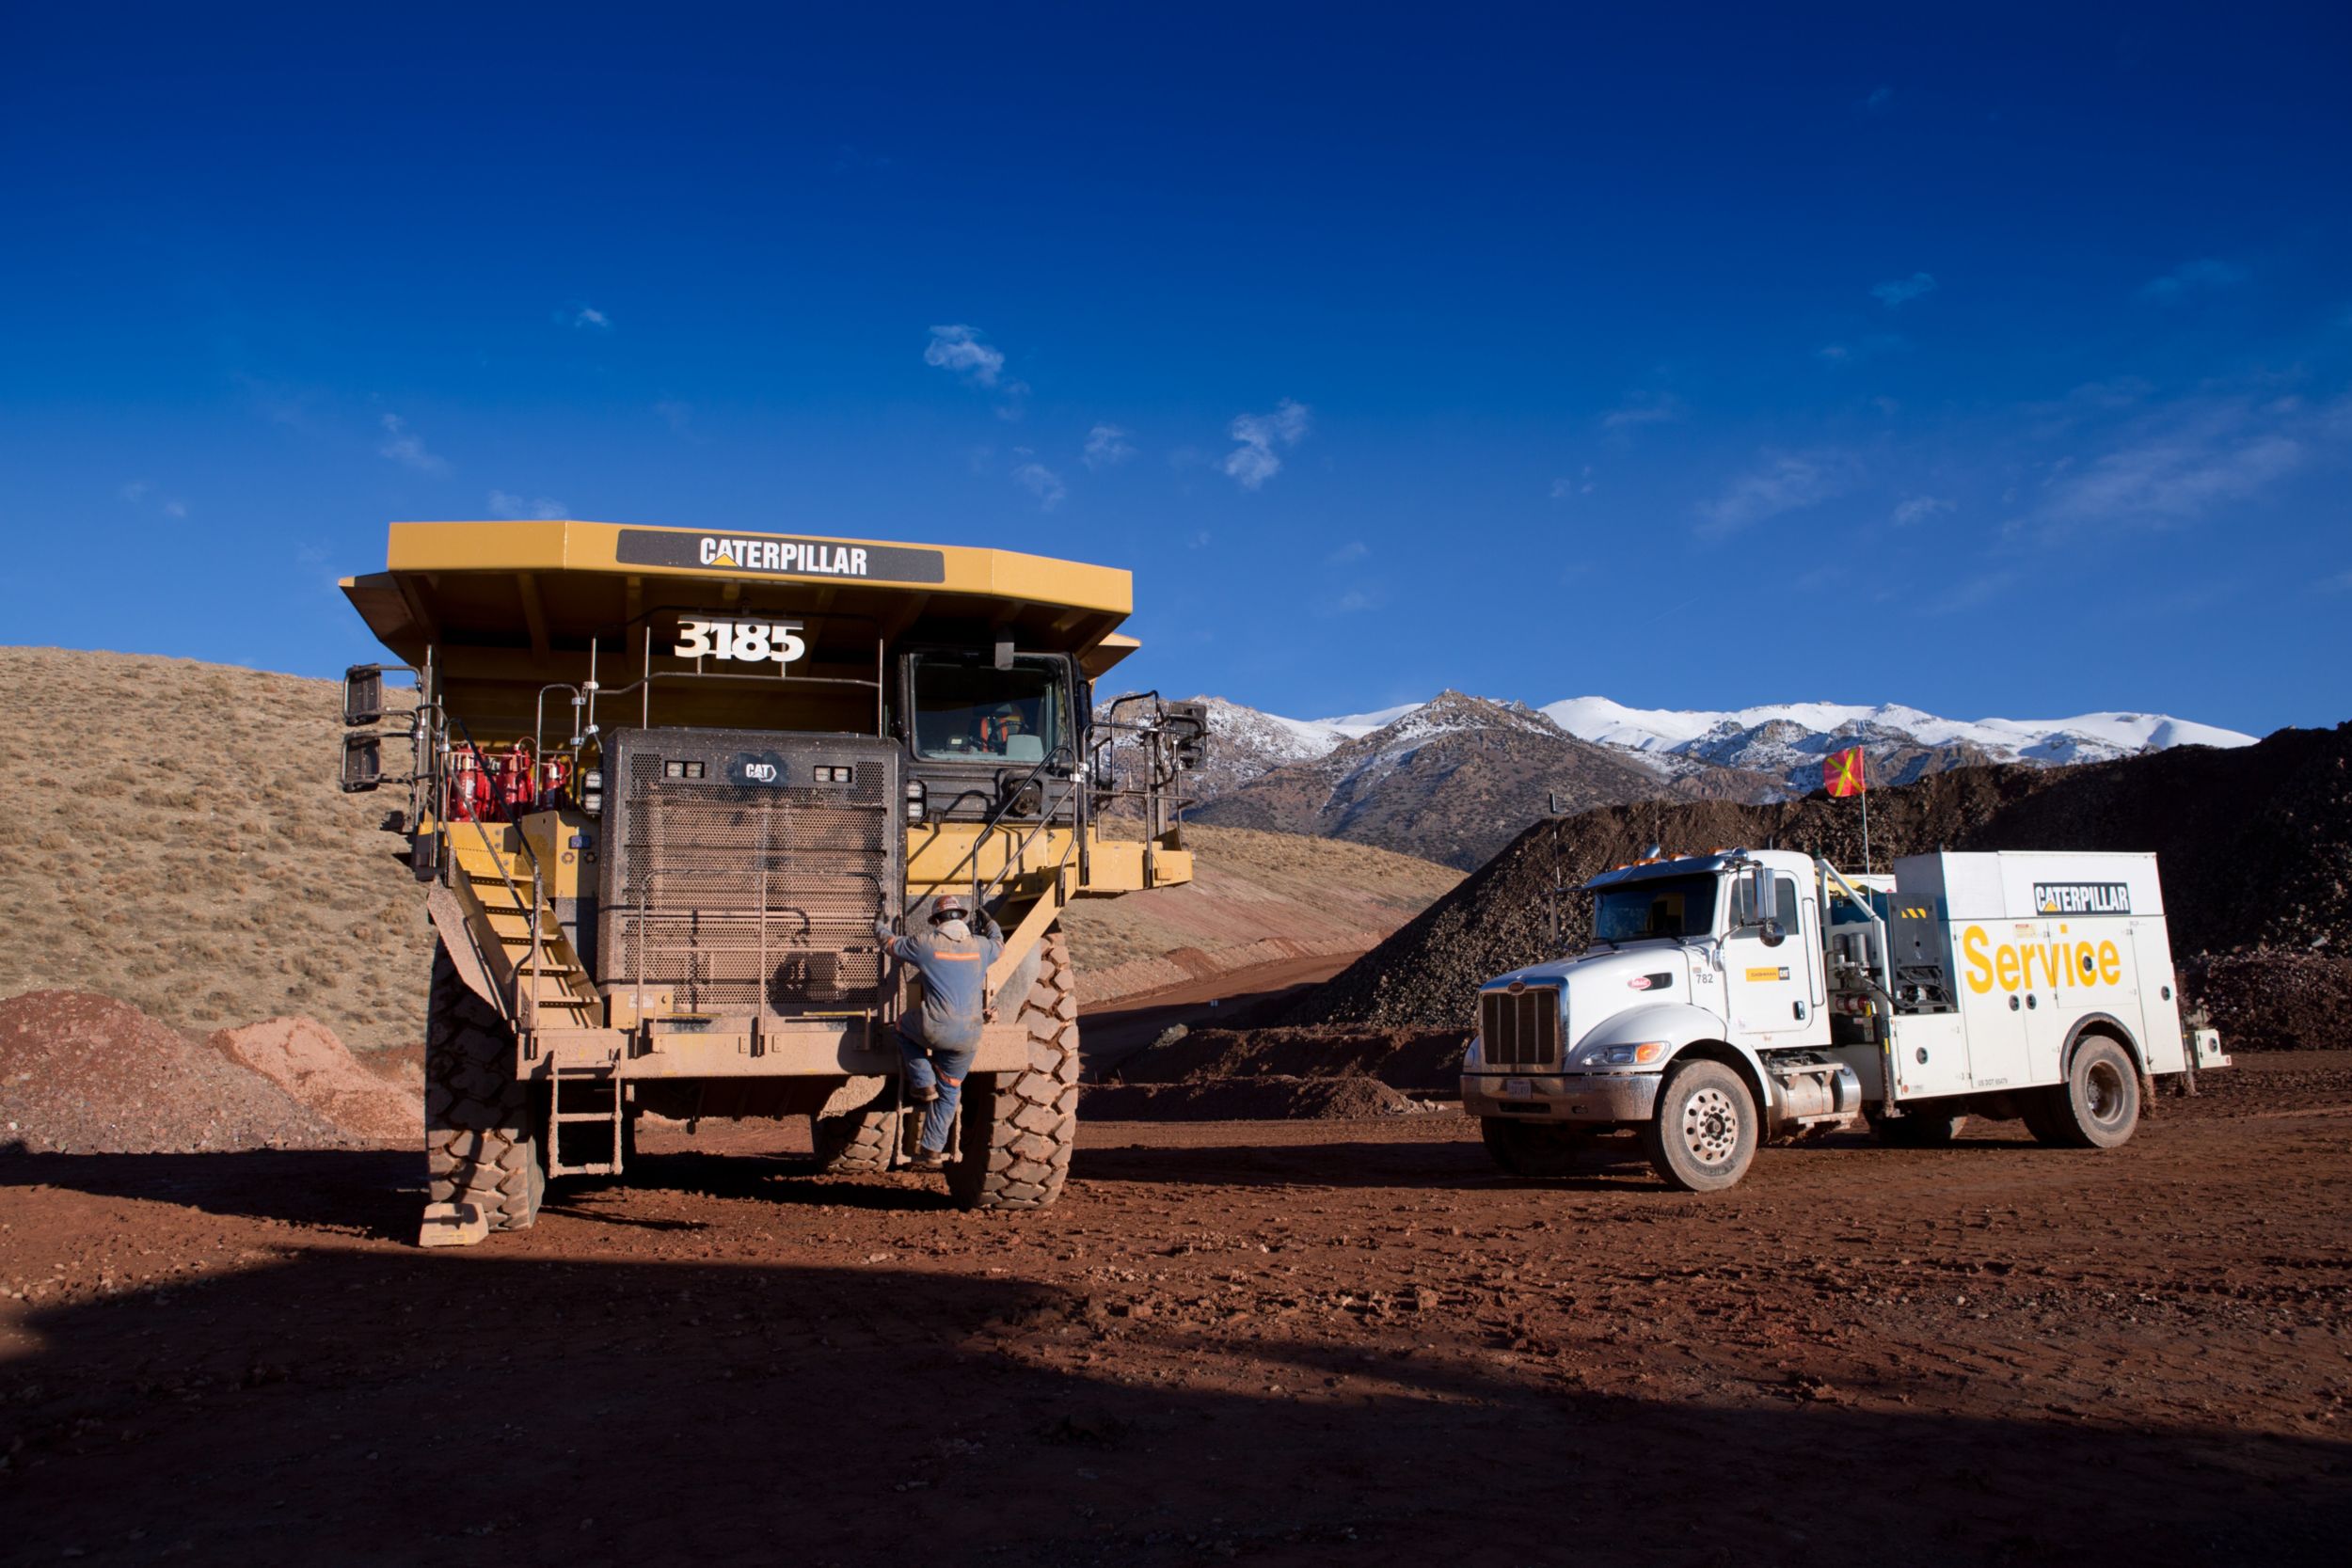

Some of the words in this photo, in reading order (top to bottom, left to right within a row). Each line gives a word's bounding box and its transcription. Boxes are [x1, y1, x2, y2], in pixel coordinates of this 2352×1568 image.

[700, 537, 867, 576] CATERPILLAR
[675, 615, 805, 662] 3185
[746, 763, 773, 779] CAT
[2034, 885, 2130, 912] CATERPILLAR
[1963, 925, 2122, 994] Service
[1696, 974, 1714, 984] 782
